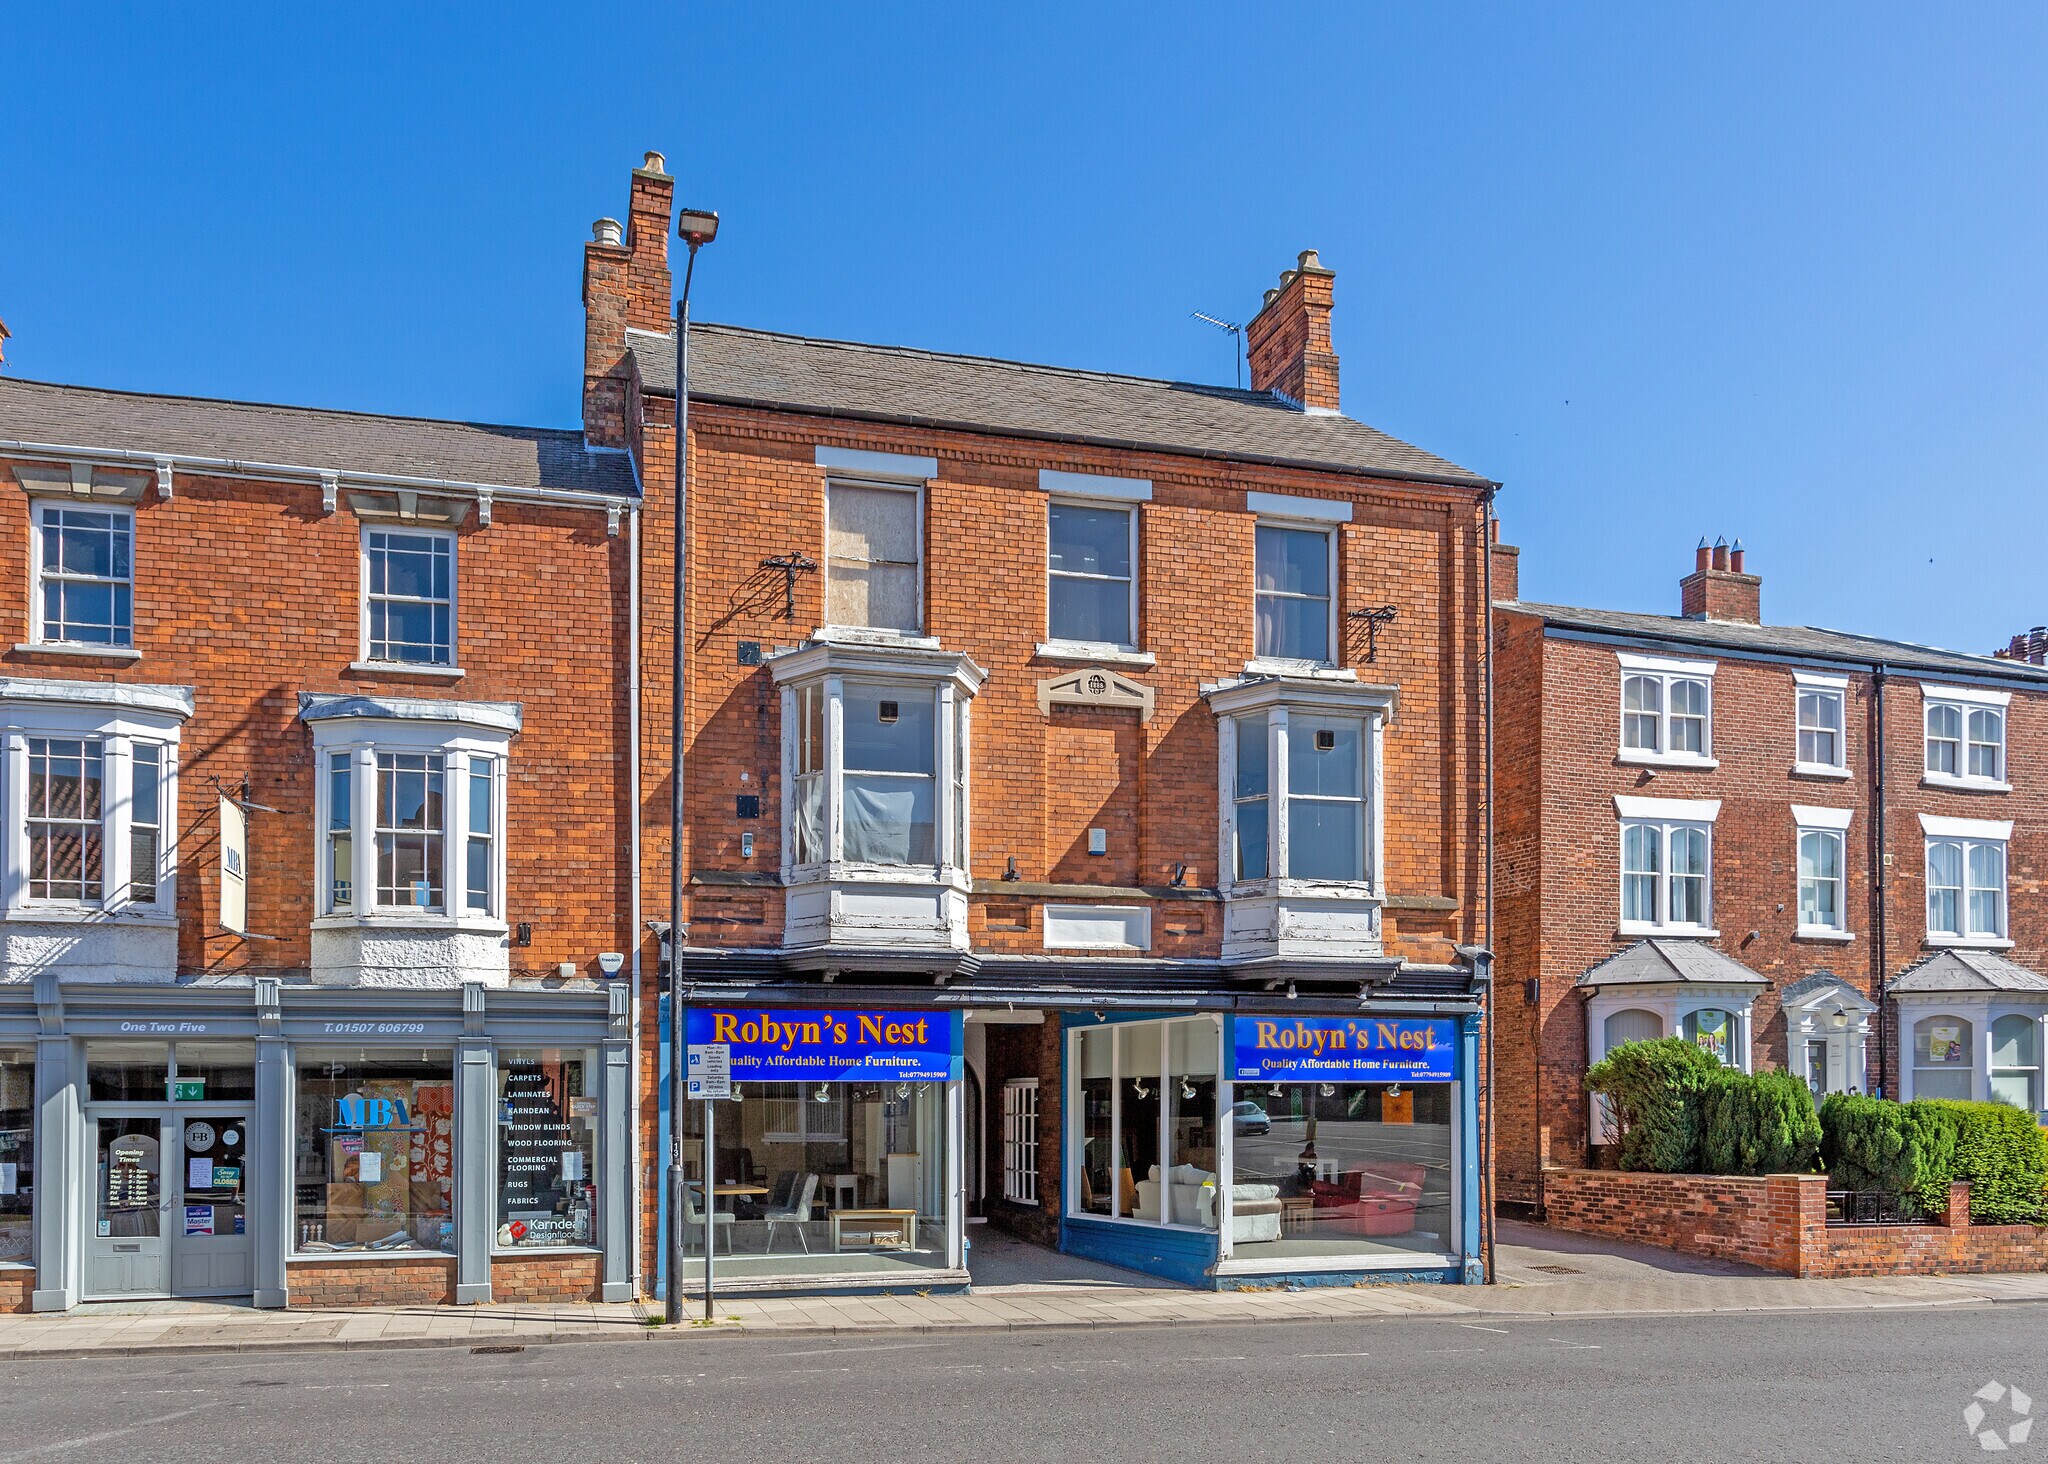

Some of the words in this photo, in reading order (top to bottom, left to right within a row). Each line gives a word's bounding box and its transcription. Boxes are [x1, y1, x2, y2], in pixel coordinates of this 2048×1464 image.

[226, 846, 241, 874] MBA
[121, 1022, 146, 1031] One
[150, 1022, 175, 1031] Two
[179, 1022, 206, 1031] Five
[378, 1023, 424, 1032] 606799
[712, 1013, 848, 1052] Robyn’s
[856, 1014, 928, 1044] Nest
[1255, 1022, 1369, 1056] Robyn’s
[1376, 1023, 1436, 1050] Nest
[730, 1056, 762, 1068] uality
[765, 1055, 825, 1066] Affordable
[829, 1056, 862, 1066] Home
[865, 1056, 921, 1066] Furniture.
[1262, 1059, 1298, 1071] Quality
[1300, 1059, 1350, 1068] Affordable
[1353, 1059, 1380, 1068] Home
[1383, 1060, 1430, 1068] Furniture.
[692, 1083, 699, 1091] P
[334, 1098, 412, 1126] MBA
